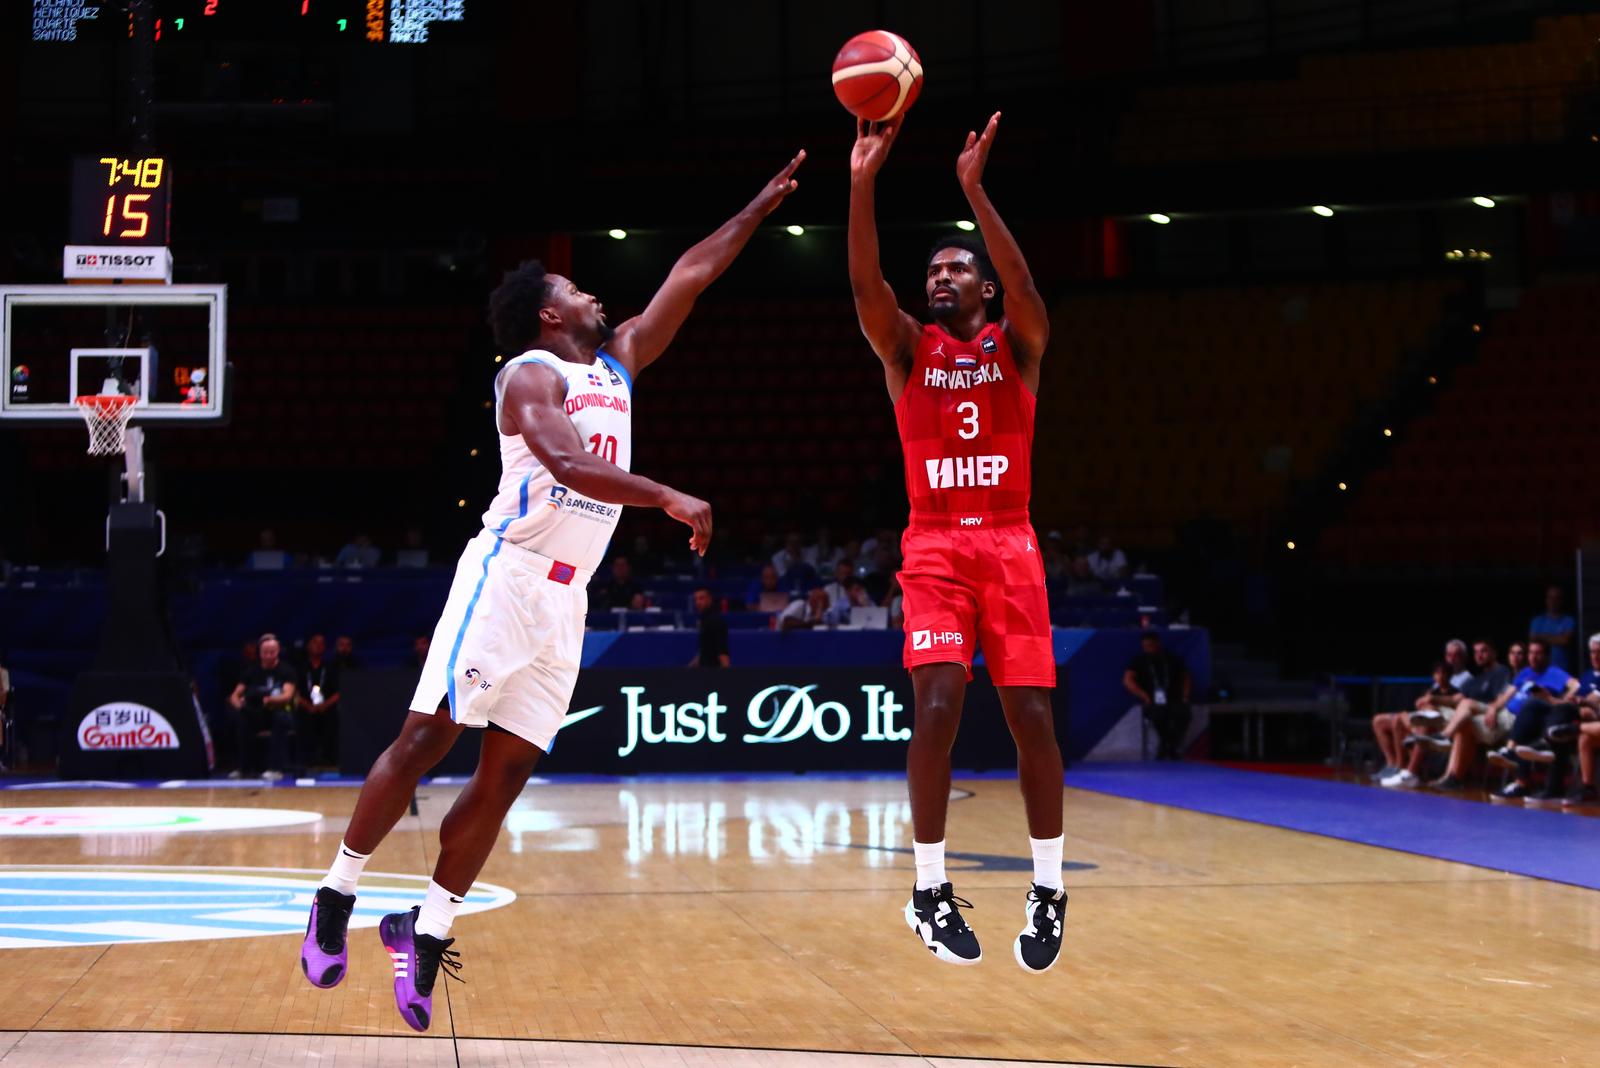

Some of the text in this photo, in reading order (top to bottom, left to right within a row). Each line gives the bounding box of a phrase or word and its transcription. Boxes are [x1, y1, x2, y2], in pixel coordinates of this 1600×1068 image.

[32, 29, 77, 41] SANTOS
[100, 157, 164, 188] 7:48
[103, 194, 151, 238] 15
[99, 255, 155, 266] TISSOT
[924, 362, 1004, 390] HRVATSKA
[565, 393, 630, 416] DOMINICANA
[956, 401, 979, 440] 3
[956, 455, 1009, 487] HEP
[960, 517, 983, 526] HRV
[933, 631, 963, 645] HPB
[95, 710, 151, 726] 百岁山
[618, 684, 912, 757] Just Do It.
